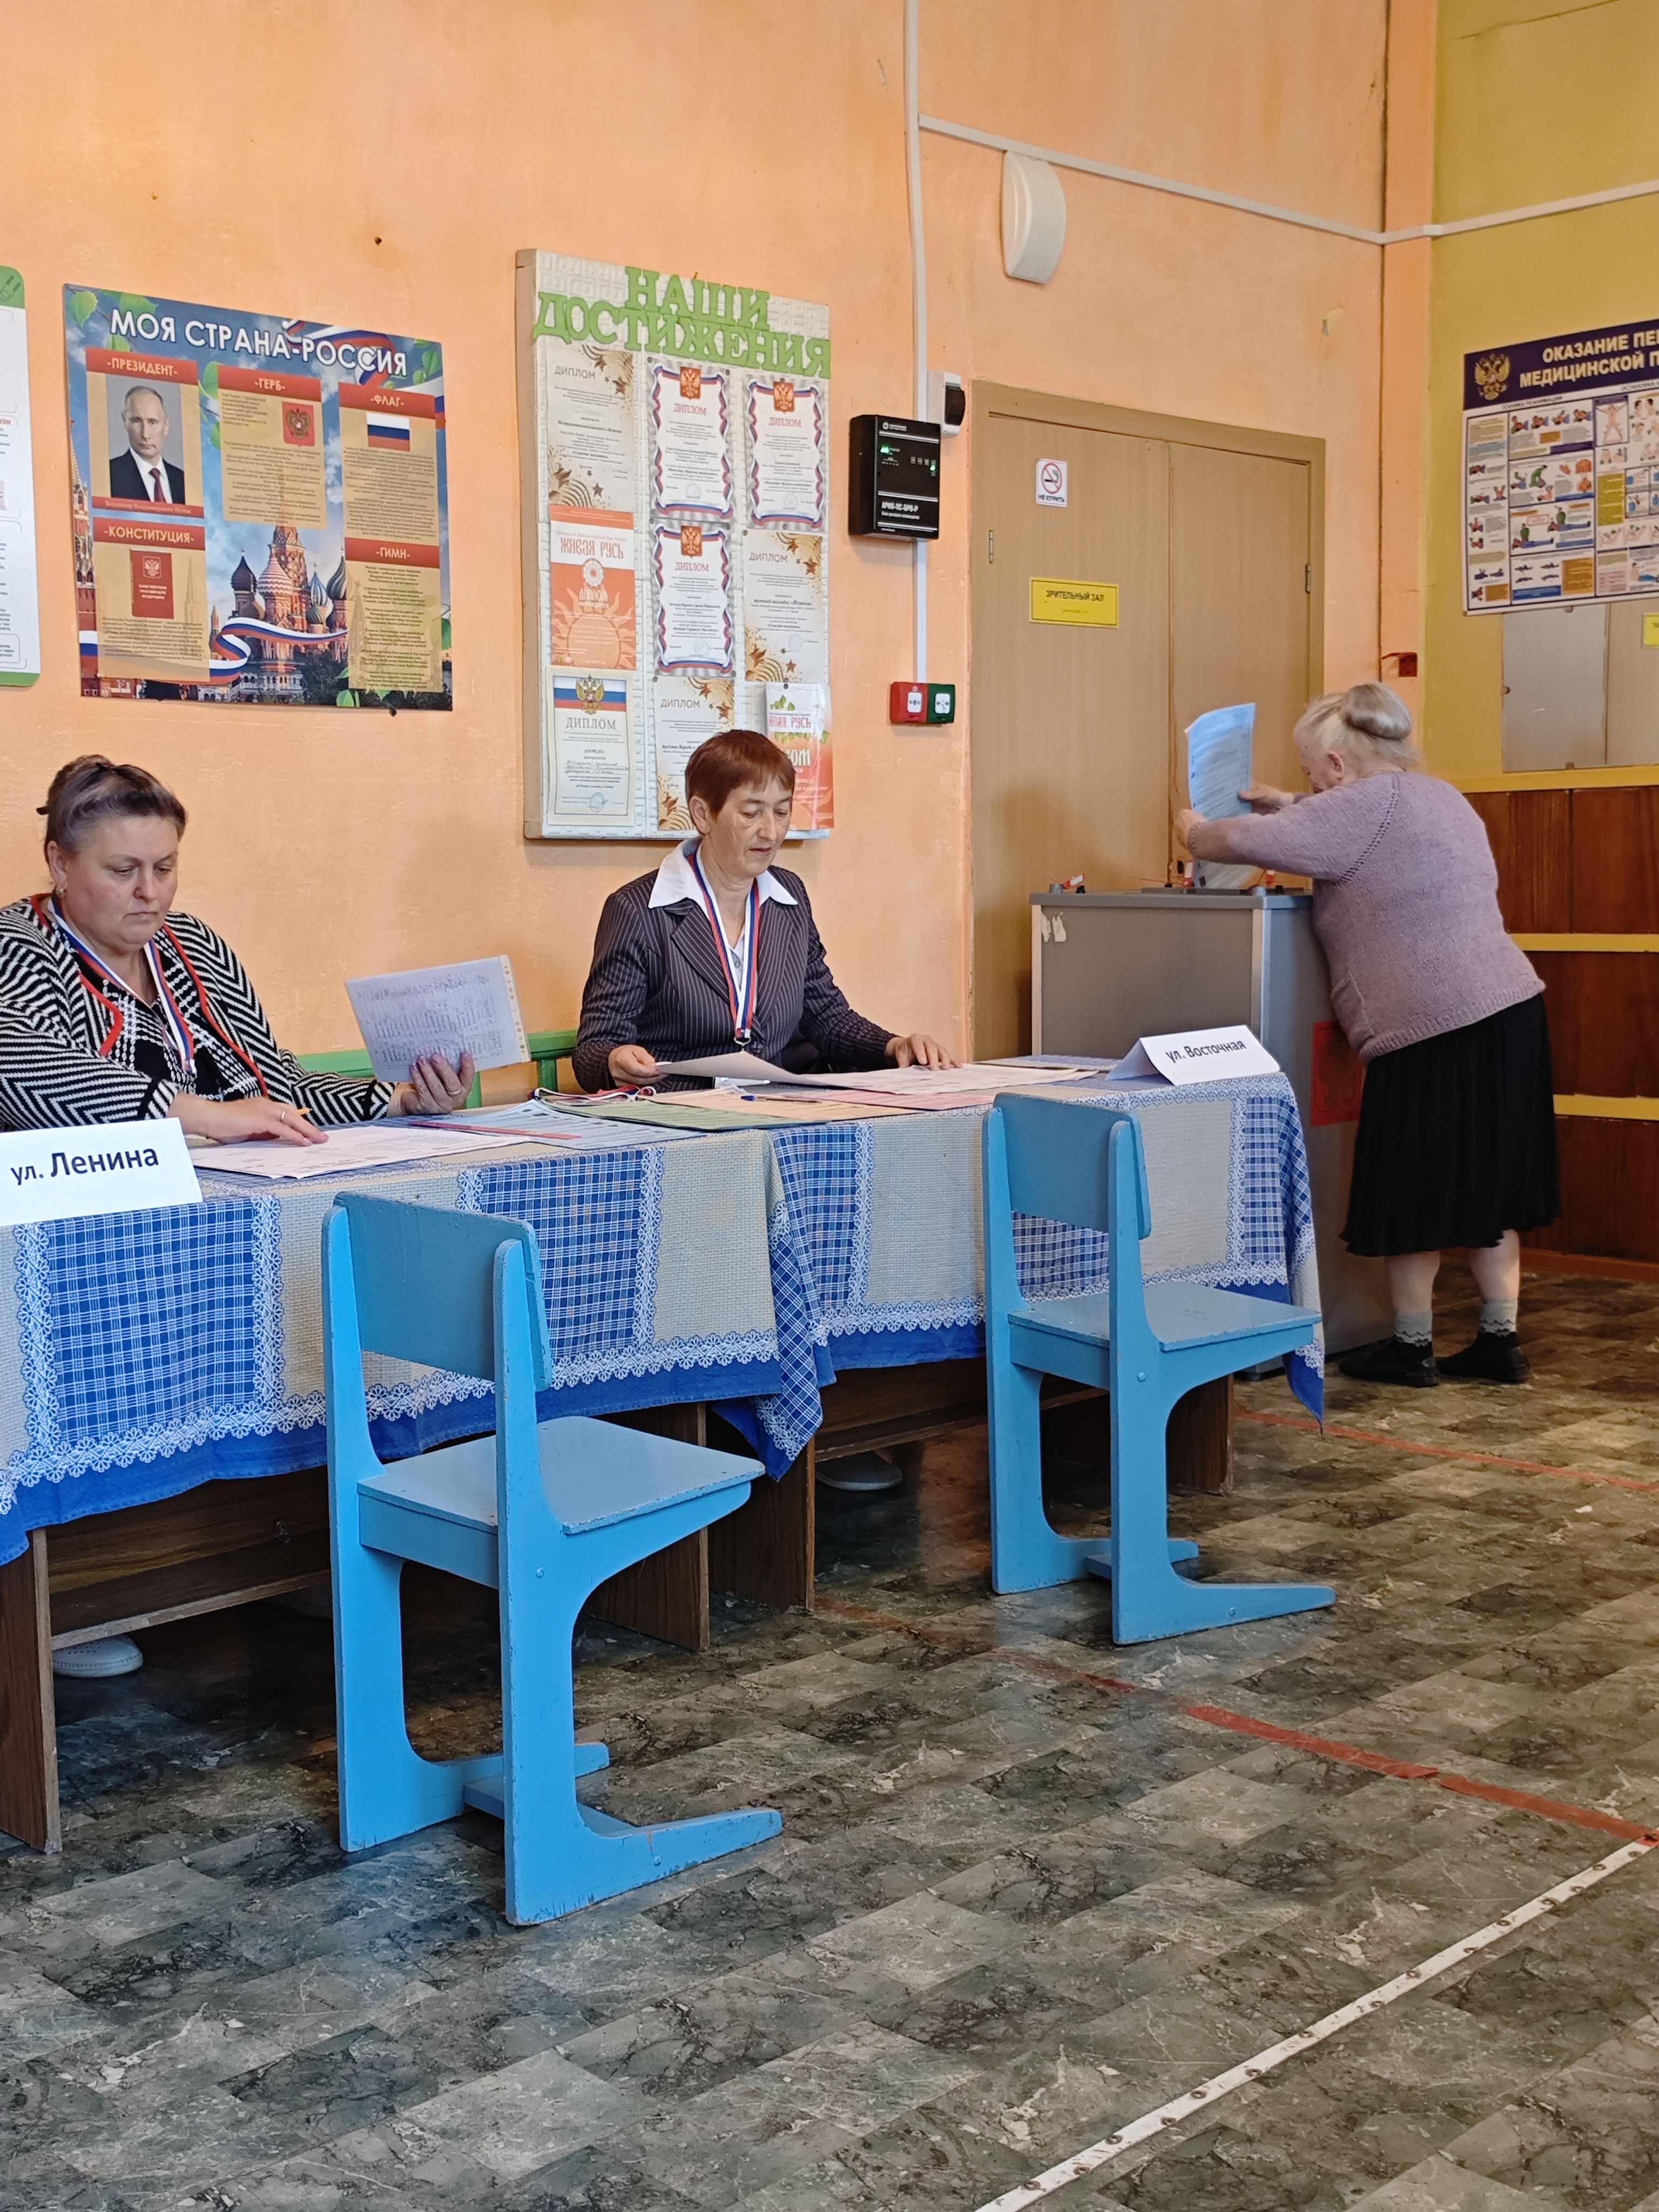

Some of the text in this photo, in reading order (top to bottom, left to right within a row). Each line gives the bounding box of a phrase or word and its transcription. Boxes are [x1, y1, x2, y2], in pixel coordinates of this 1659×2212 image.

[625, 266, 770, 331] НАШИ
[110, 308, 176, 343] МОЯ
[533, 291, 831, 379] ДОСТИЖЕНИЯ
[1542, 333, 1629, 363] ОКАЗАНИЕ
[554, 365, 596, 380] ДИПЛОМ
[1519, 350, 1645, 388] МЕДИЦИНСКОЙ
[673, 403, 707, 416] ДИПЛОМ
[768, 417, 802, 428] ДИПЛОМ
[600, 541, 624, 559] РУСЬ
[748, 552, 788, 563] ДИПЛОМ
[675, 562, 710, 572] ДИПЛОМ
[1046, 590, 1104, 602] ЗРИТЕЛЬНЫЙ ЗАЛ
[660, 699, 700, 709] ДИПЛОМ
[566, 717, 616, 730] ДИПЛОМ
[791, 716, 811, 729] РУСЬ
[1165, 1040, 1246, 1063] ул. Восточная
[10, 1147, 159, 1185] ул. Ленина
